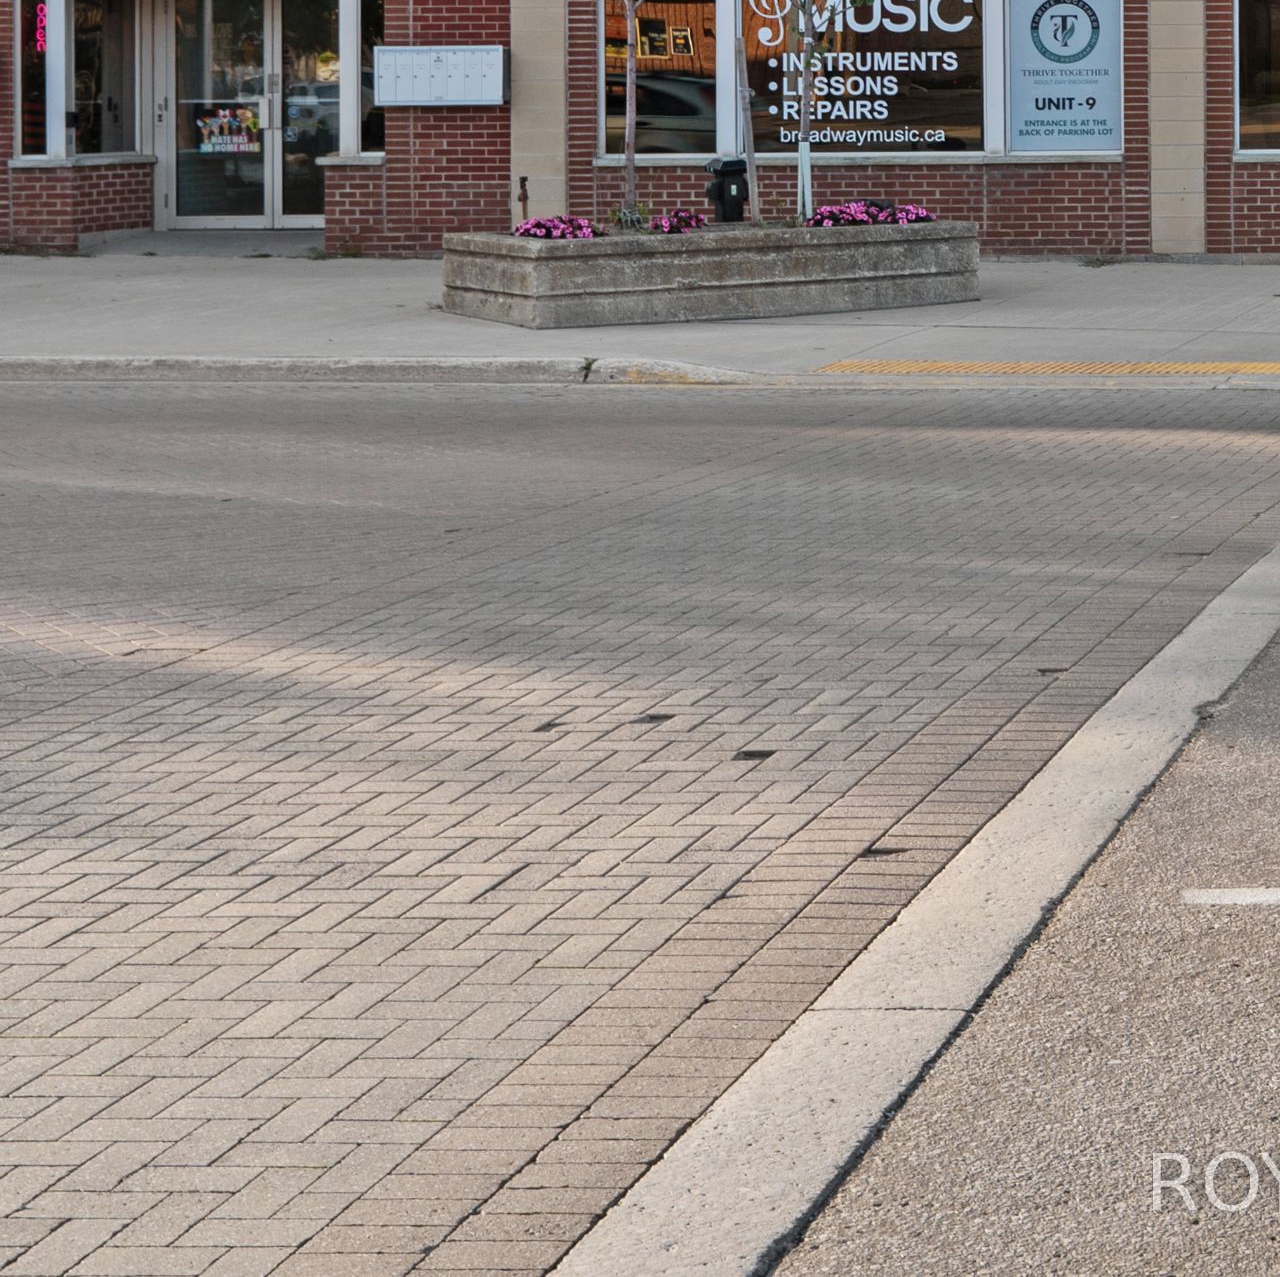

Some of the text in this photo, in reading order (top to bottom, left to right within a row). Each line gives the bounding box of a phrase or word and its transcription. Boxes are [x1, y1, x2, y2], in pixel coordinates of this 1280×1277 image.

[1032, 0, 1056, 27] THRIVE
[782, 51, 959, 72] INSTRUMENTS
[1021, 68, 1110, 77] THRIVE TOGETHER
[1024, 119, 1107, 127] ENTRANCE IS AT THE
[1018, 128, 1113, 137] BACK OF PARKING LOT
[211, 134, 248, 143] HATE HAS
[200, 143, 259, 153] NO HOME HERE
